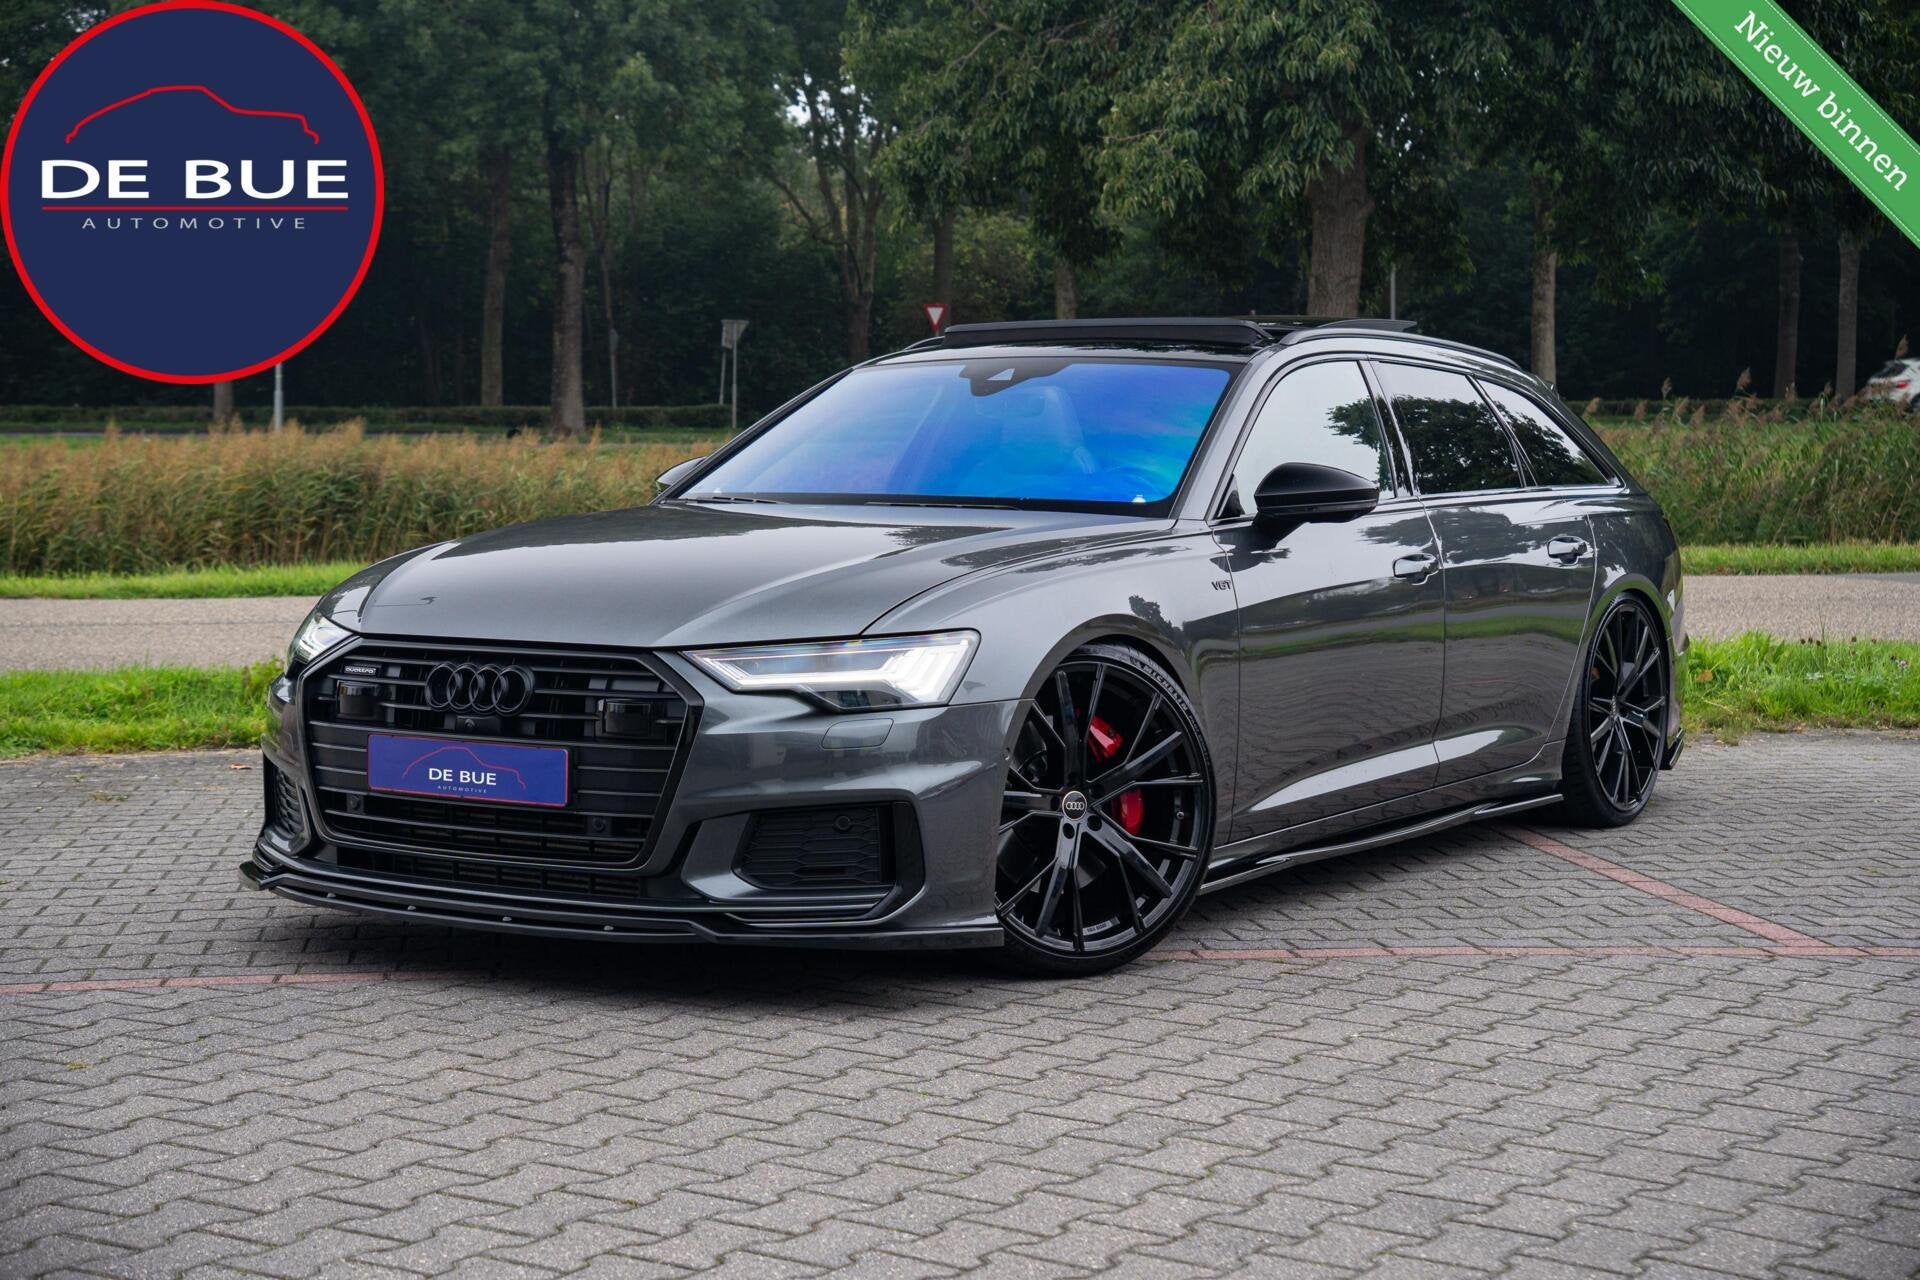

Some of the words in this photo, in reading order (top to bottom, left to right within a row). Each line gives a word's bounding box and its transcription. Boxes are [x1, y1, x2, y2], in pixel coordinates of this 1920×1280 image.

[428, 767, 453, 782] DE
[459, 770, 497, 786] BUE
[437, 785, 487, 794] AUTOMOTIVE
